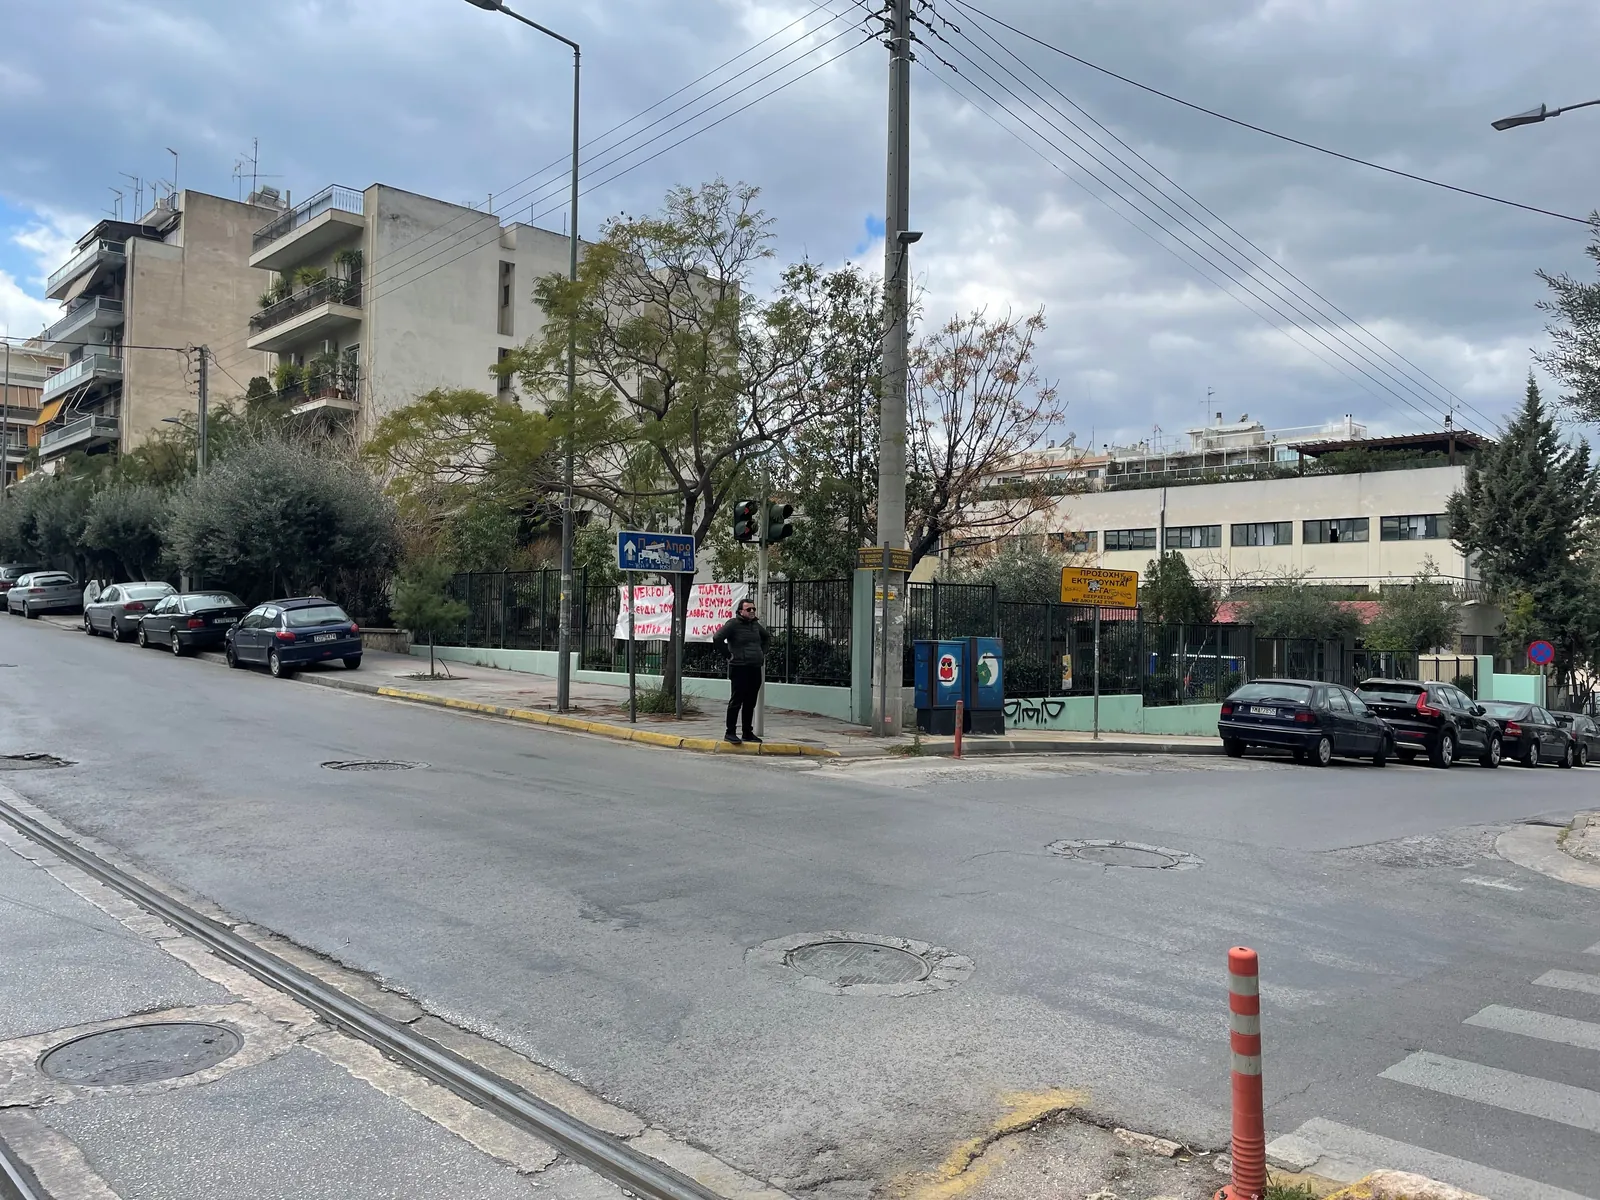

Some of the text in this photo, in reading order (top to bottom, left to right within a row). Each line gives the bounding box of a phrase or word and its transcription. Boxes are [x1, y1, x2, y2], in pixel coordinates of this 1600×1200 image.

[1080, 570, 1120, 578] ΠΡΟΣΟΧΗ
[1072, 577, 1128, 587] ΕΚΤΟΥΝΤΑΙ
[634, 604, 656, 615] ΕΡΔΗ
